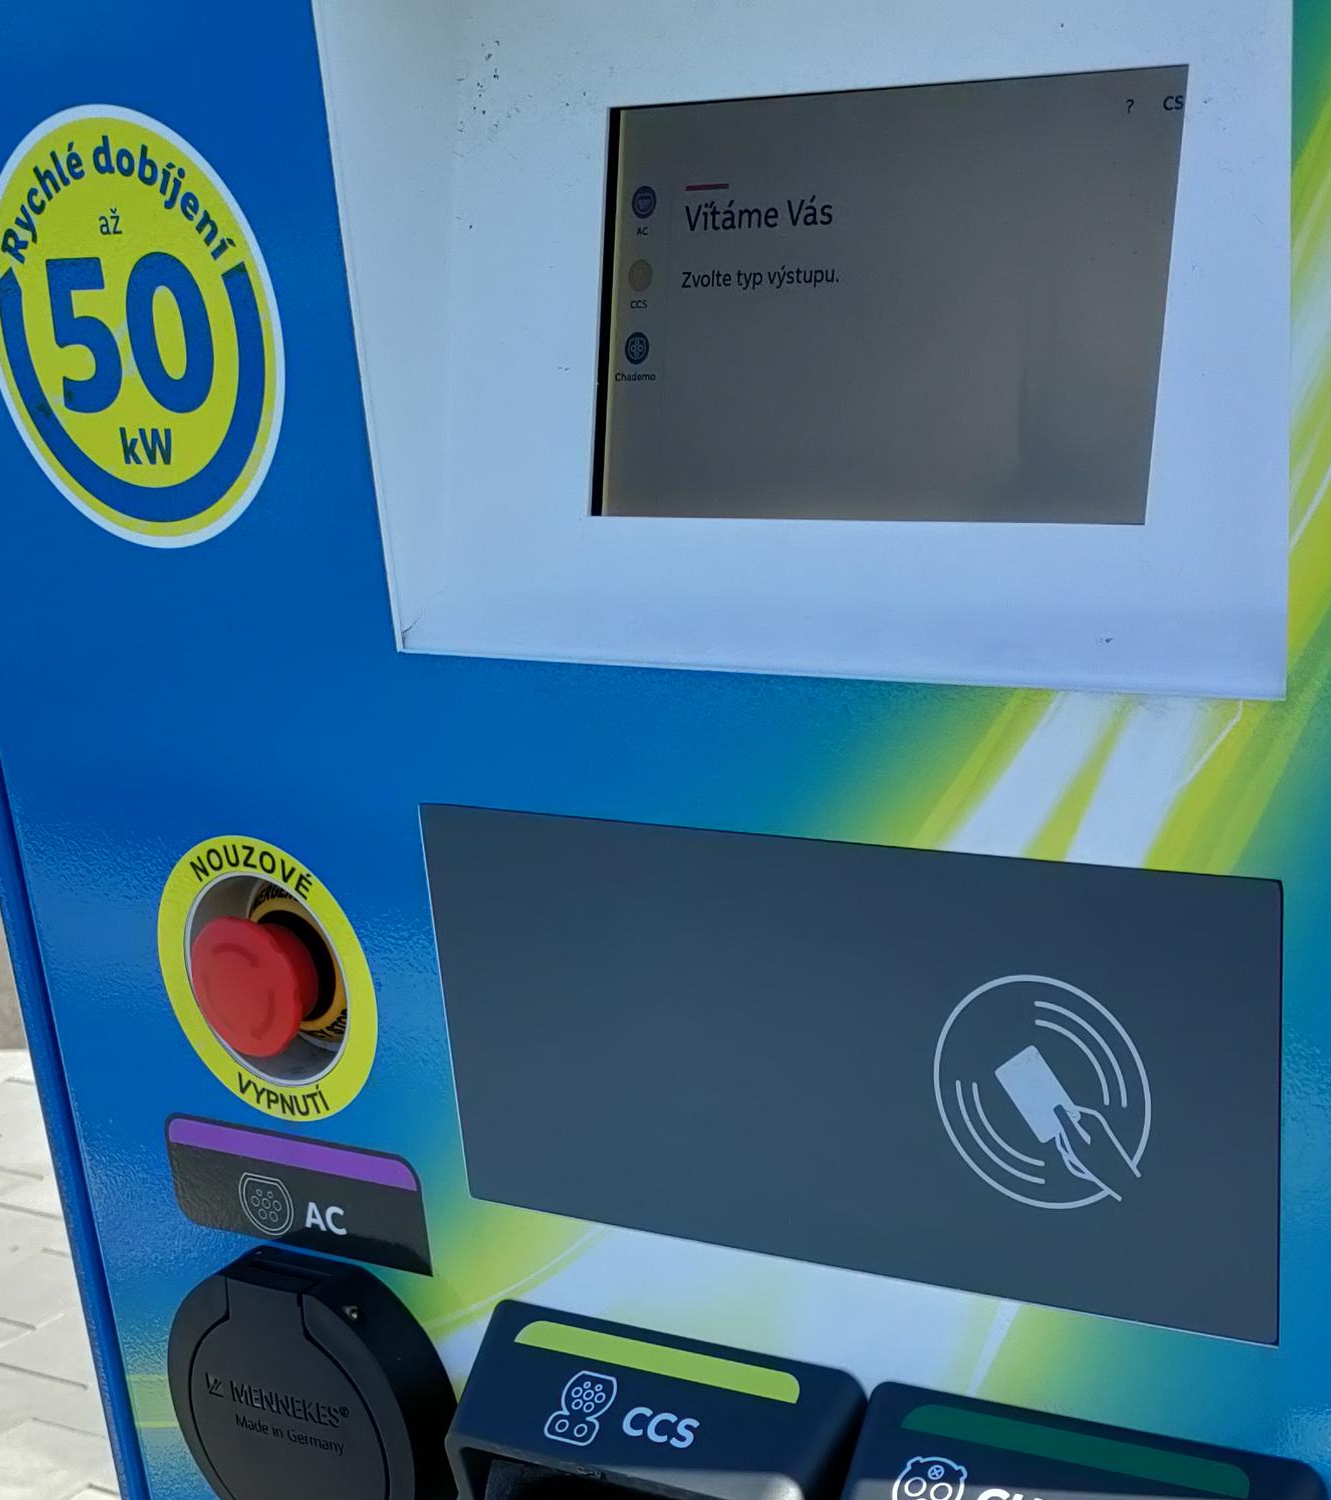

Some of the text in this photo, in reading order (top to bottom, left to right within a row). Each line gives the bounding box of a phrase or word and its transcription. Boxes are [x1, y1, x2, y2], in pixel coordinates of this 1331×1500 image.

[1163, 95, 1184, 111] CS
[1, 135, 235, 264] Rychlé dobíjení
[684, 194, 834, 231] Vítáme Vás
[99, 208, 124, 236] až
[636, 226, 649, 236] AC
[681, 265, 840, 290] Zvolte typ výstupu.
[630, 300, 648, 309] CCS
[45, 251, 215, 414] 50
[614, 371, 656, 382] Chademo
[119, 426, 172, 466] kW
[189, 844, 314, 901] NOUZOVÉ
[236, 1072, 331, 1117] VYPNUTÍ
[305, 1202, 348, 1236] AC
[235, 1413, 345, 1457] Made in Germany
[622, 1406, 701, 1449] CCS
